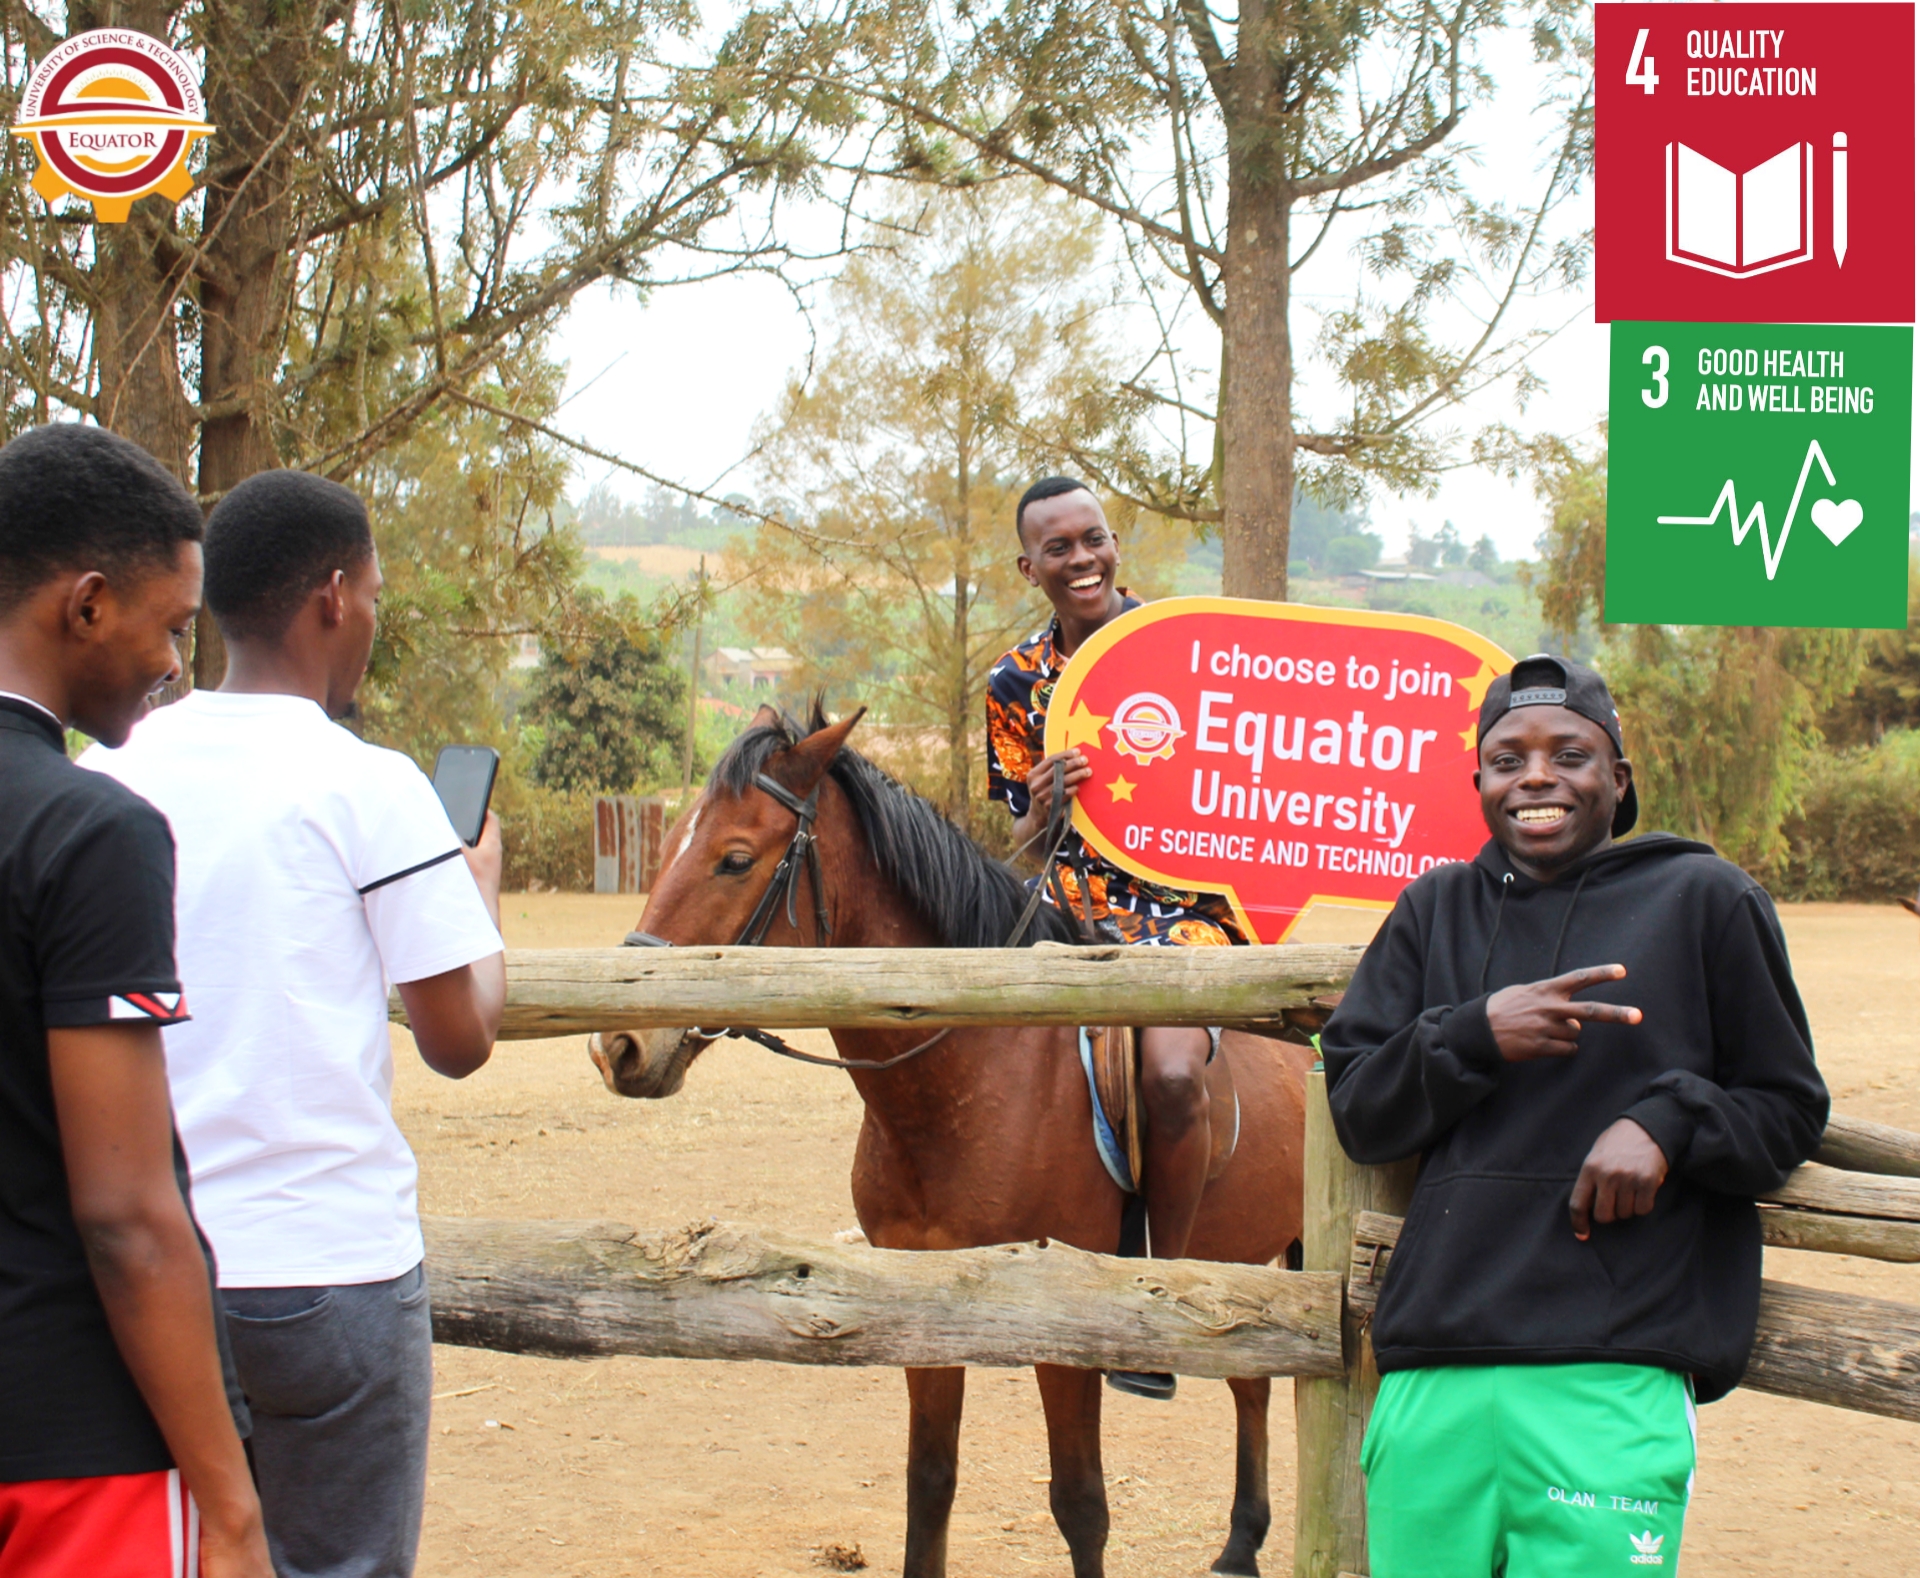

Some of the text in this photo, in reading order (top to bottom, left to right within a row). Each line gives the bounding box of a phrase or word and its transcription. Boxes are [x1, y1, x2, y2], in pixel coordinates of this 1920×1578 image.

[1190, 639, 1453, 702] I choose to join
[1195, 690, 1438, 774] Equator
[1191, 768, 1416, 848] University
[1124, 824, 1466, 879] OF SCIENCE AND TECHNOLO
[1547, 1486, 1659, 1515] OLAN TEAM
[1629, 1553, 1664, 1565] adidas
